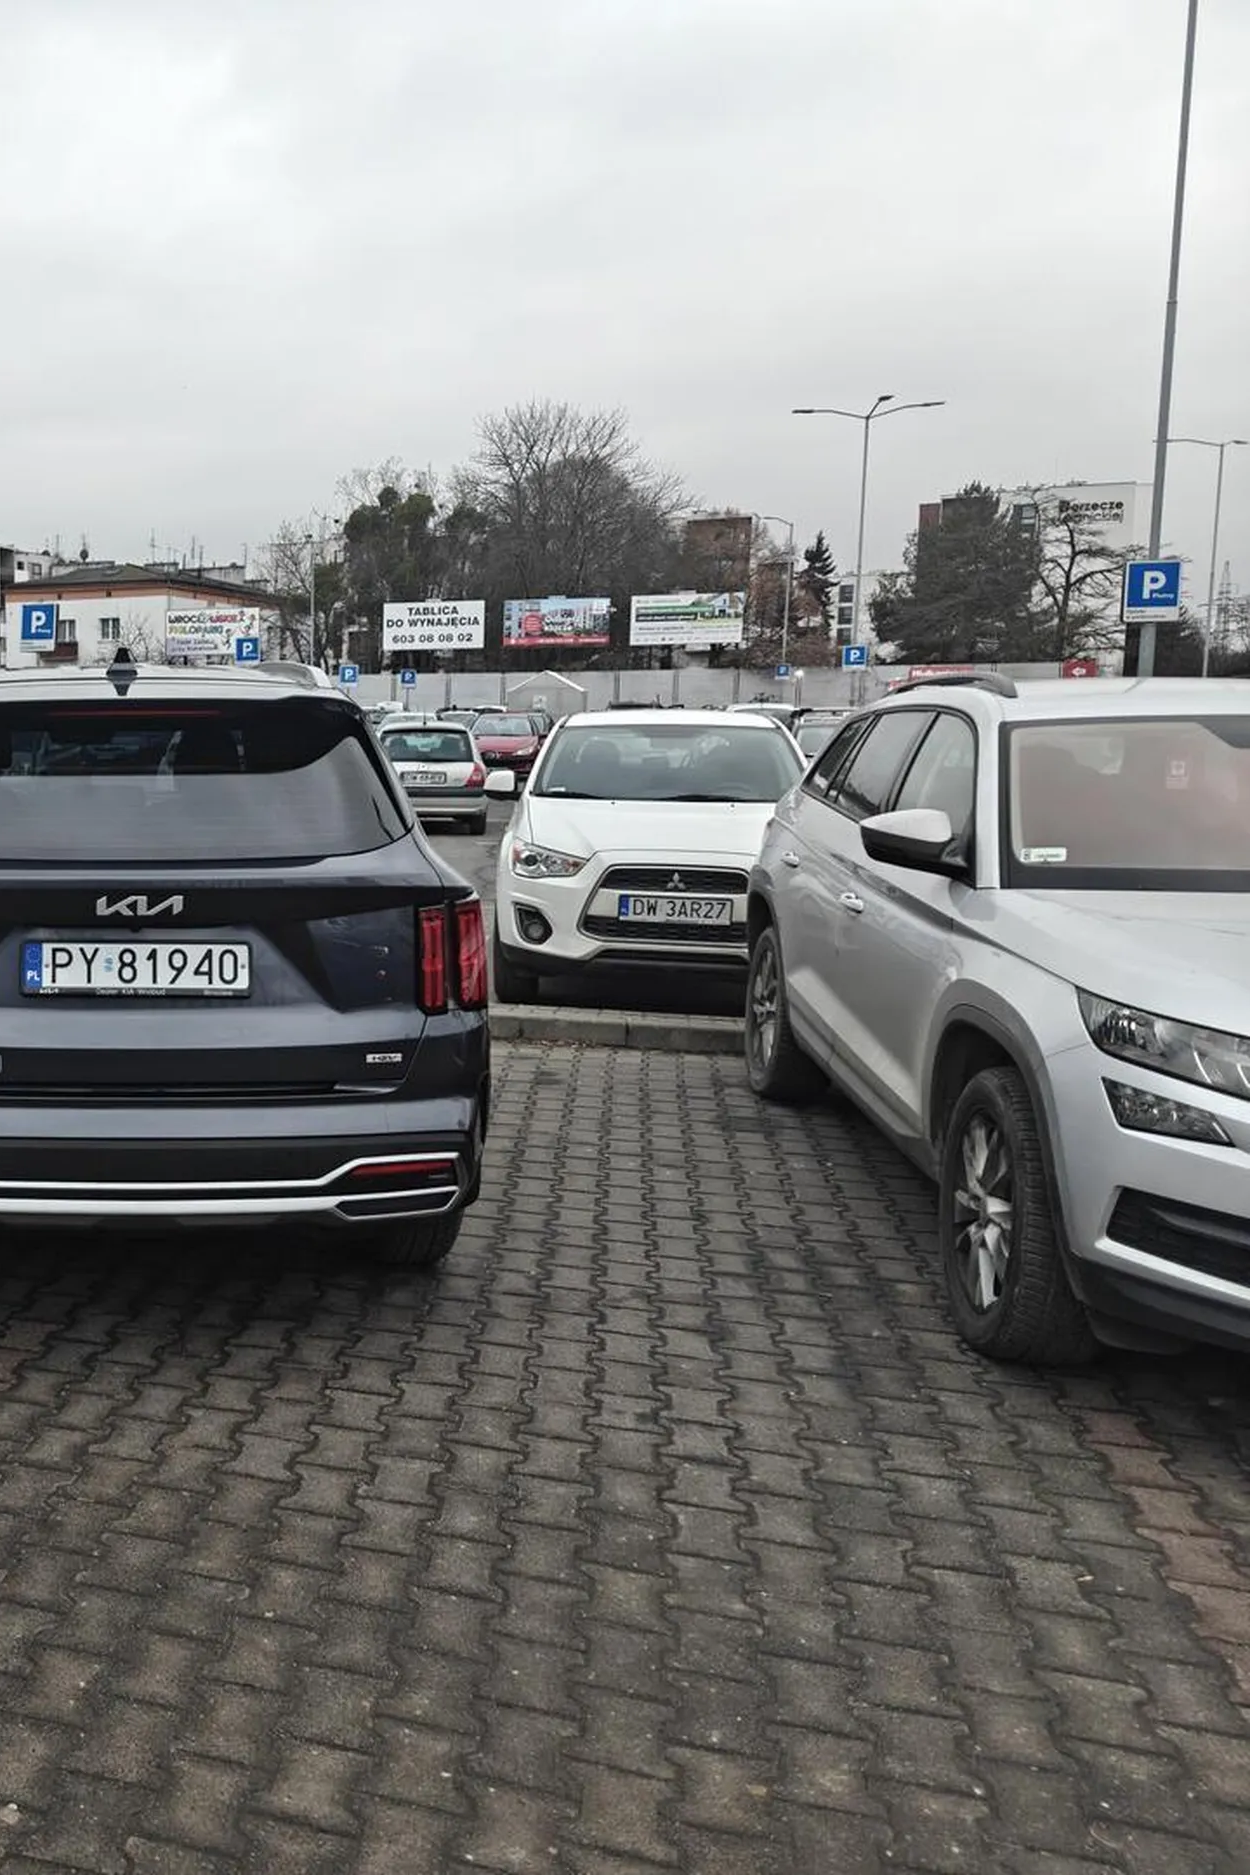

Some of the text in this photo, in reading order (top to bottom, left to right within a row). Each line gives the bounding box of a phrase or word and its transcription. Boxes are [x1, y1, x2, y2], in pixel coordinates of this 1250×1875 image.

[1142, 571, 1167, 600] P
[407, 606, 460, 617] TABLICA
[31, 611, 47, 634] P
[386, 616, 480, 629] DO WYNAJĘCIA
[391, 633, 473, 644] 603 08 08 02
[632, 899, 727, 919] DW 3AR27
[51, 946, 239, 985] PY 81940
[27, 970, 41, 981] PL
